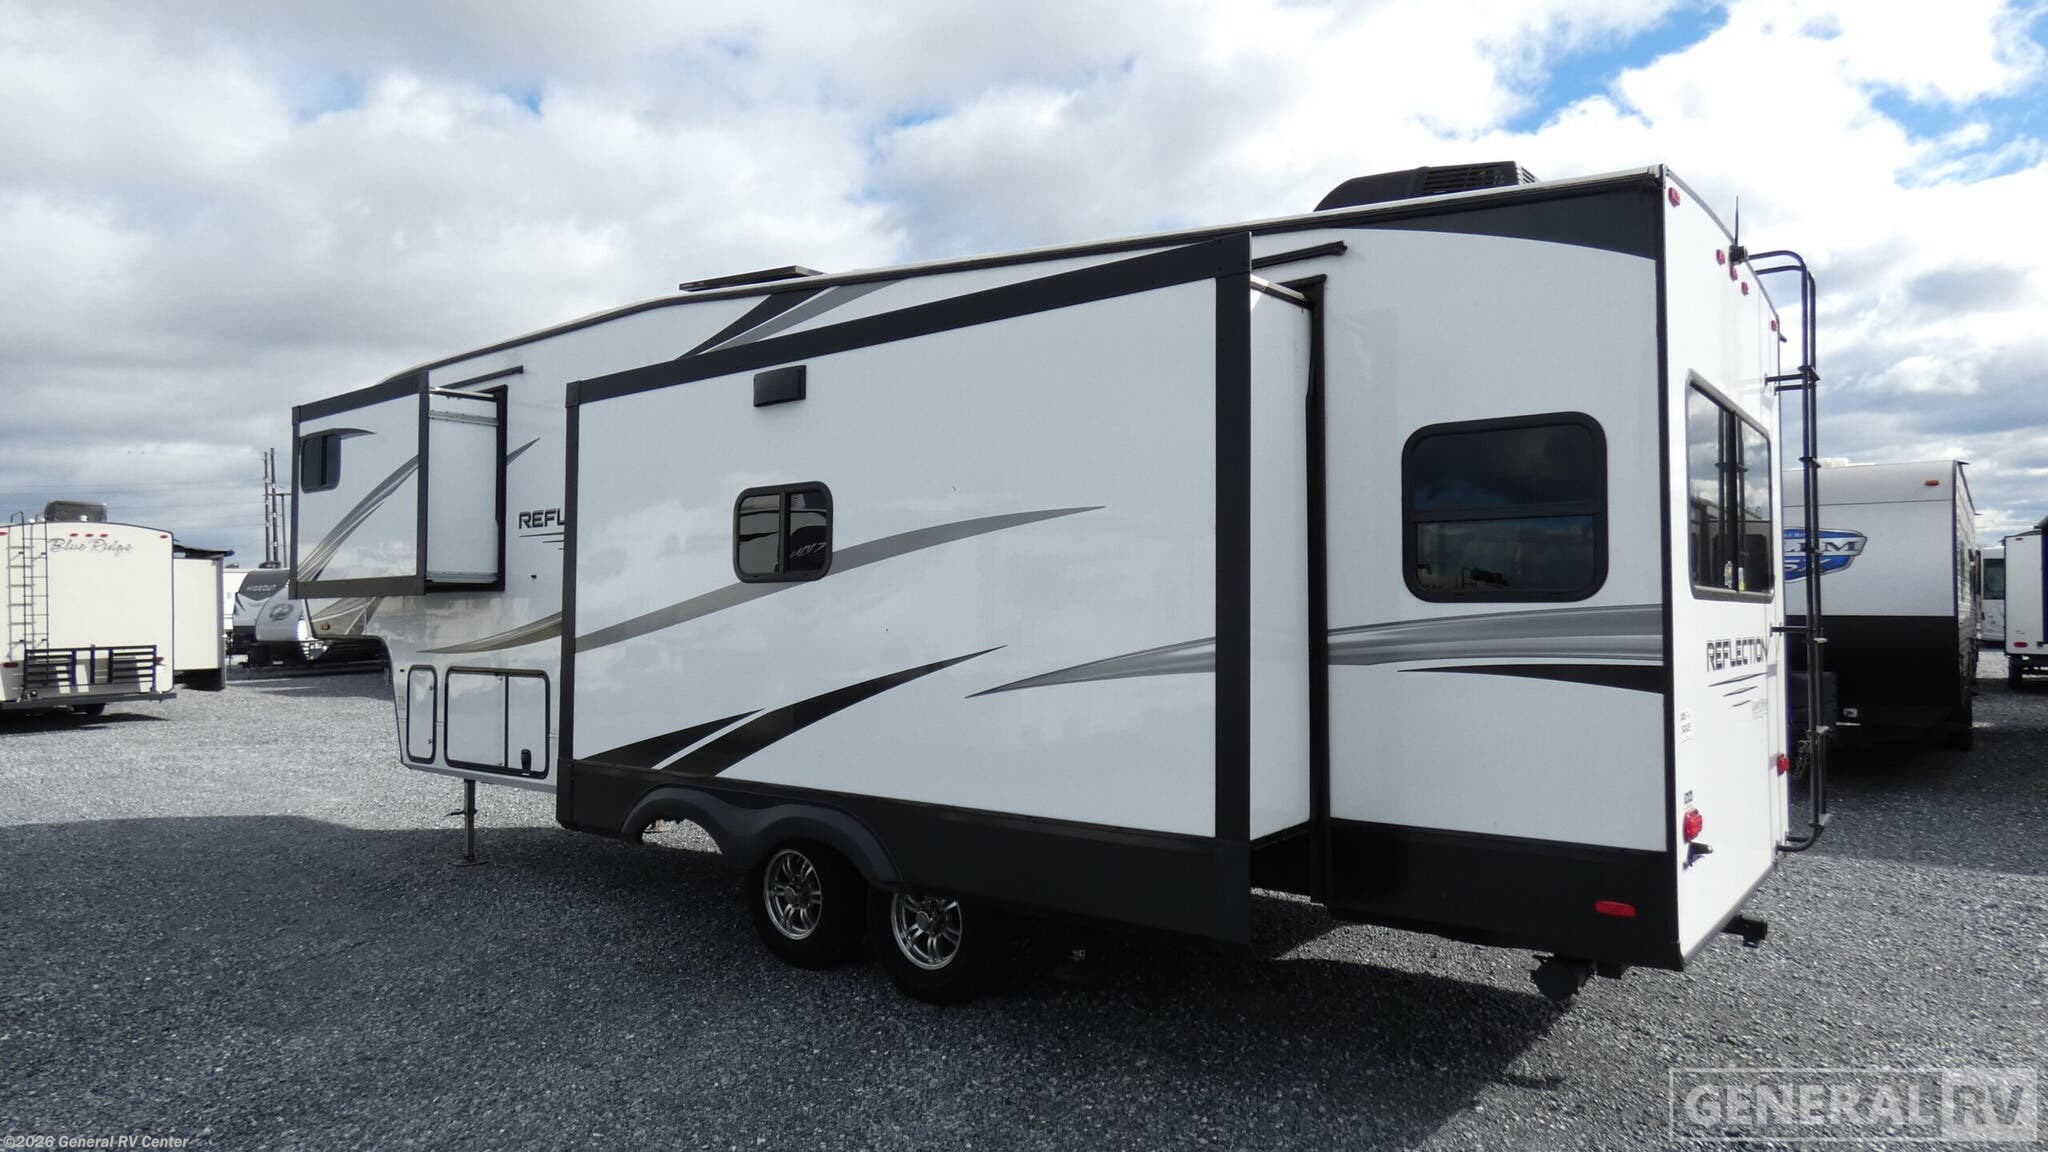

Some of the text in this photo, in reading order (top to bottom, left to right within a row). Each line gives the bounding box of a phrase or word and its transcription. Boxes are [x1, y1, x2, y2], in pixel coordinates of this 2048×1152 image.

[48, 538, 134, 557] Blue Ridge
[1706, 636, 1767, 672] REFLECTION
